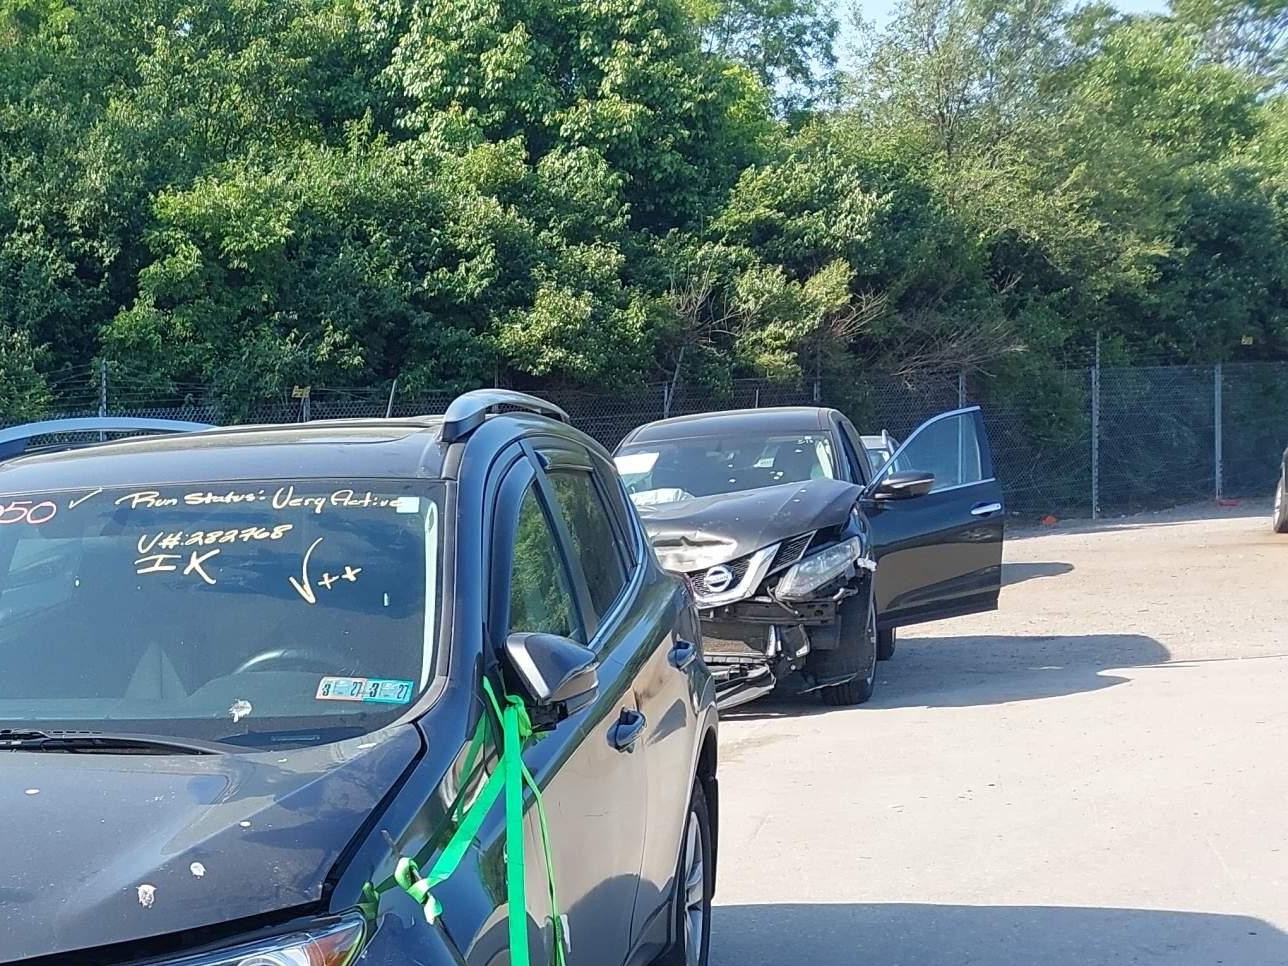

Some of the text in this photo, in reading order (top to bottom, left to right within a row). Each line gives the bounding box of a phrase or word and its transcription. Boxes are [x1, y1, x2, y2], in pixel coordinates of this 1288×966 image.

[114, 486, 406, 514] Run Status: Very Active
[322, 681, 363, 698] 3 27
[369, 682, 410, 700] 3 27
